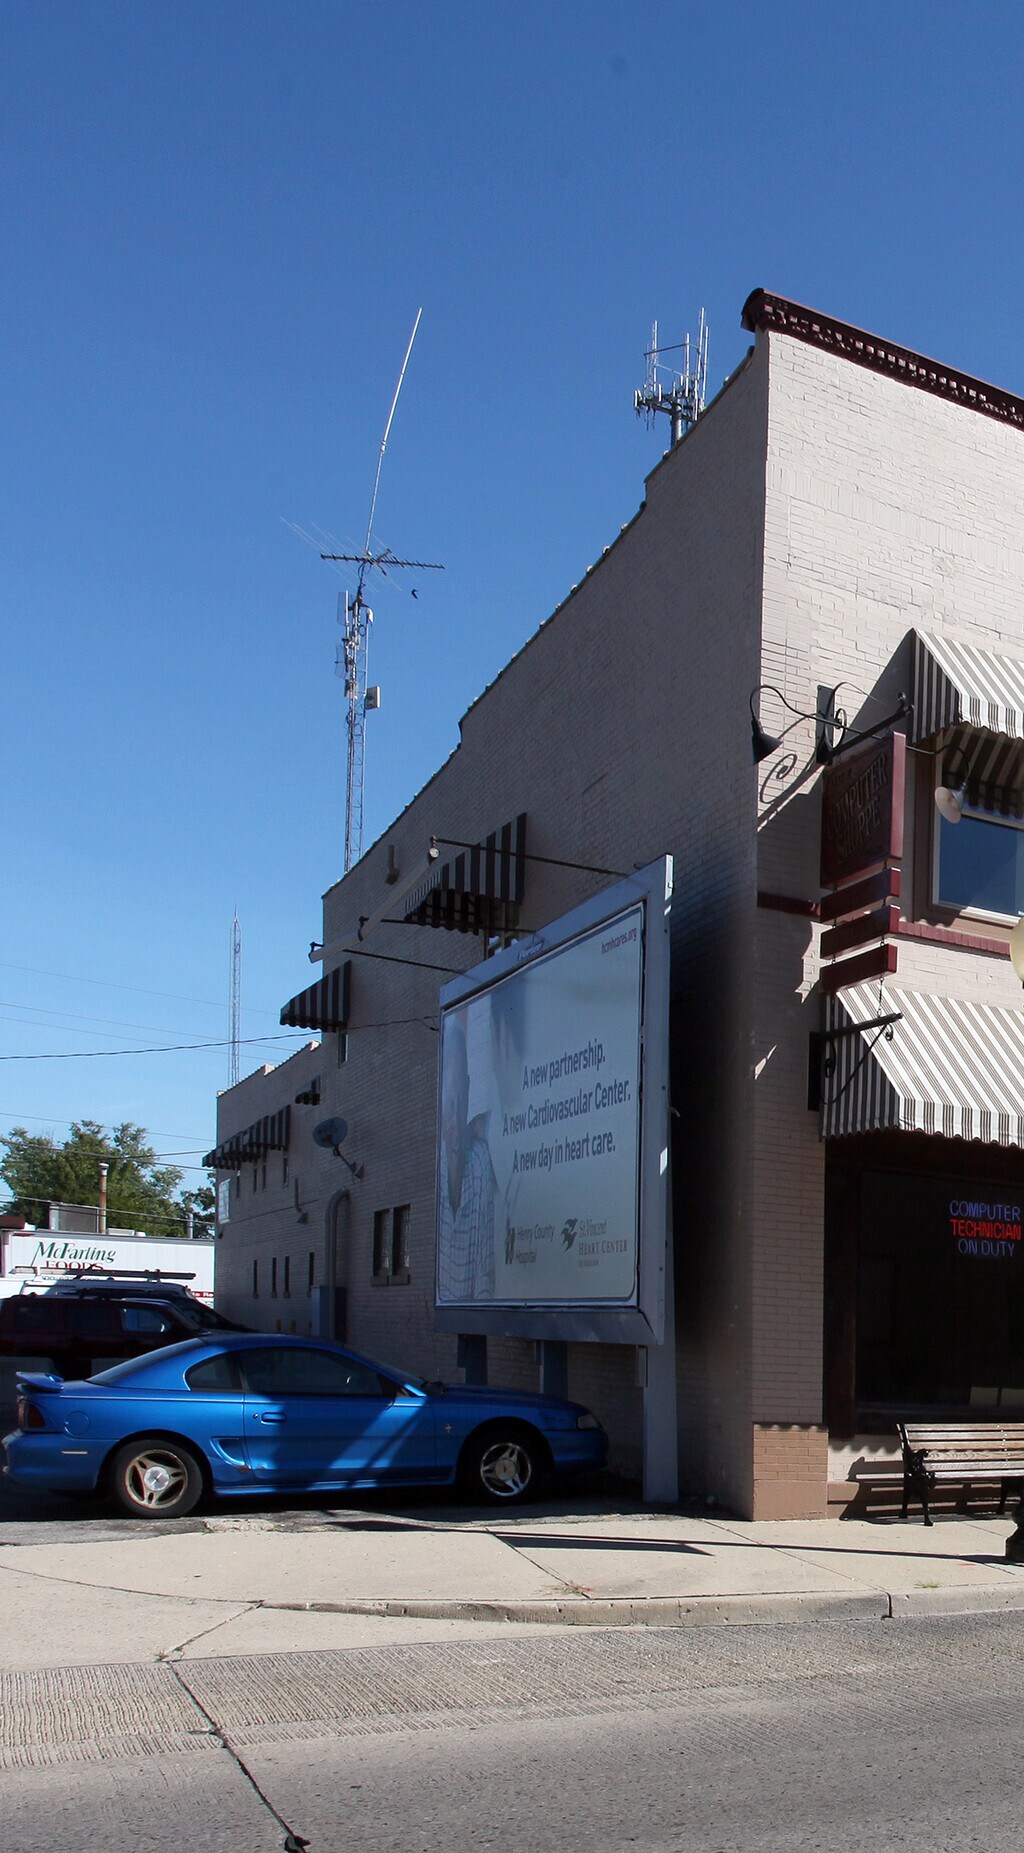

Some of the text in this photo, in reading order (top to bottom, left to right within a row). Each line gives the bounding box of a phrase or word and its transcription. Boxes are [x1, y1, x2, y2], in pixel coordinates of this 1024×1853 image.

[523, 1039, 606, 1091] A new partnership.
[503, 1078, 631, 1137] A new Cardiovascular Center.
[513, 1131, 616, 1174] A new day in heart care.
[949, 1199, 1021, 1221] COMPUTER
[949, 1218, 1022, 1240] TECHNICIAN
[32, 1241, 117, 1266] McFarling
[958, 1238, 1015, 1257] ON DUTY
